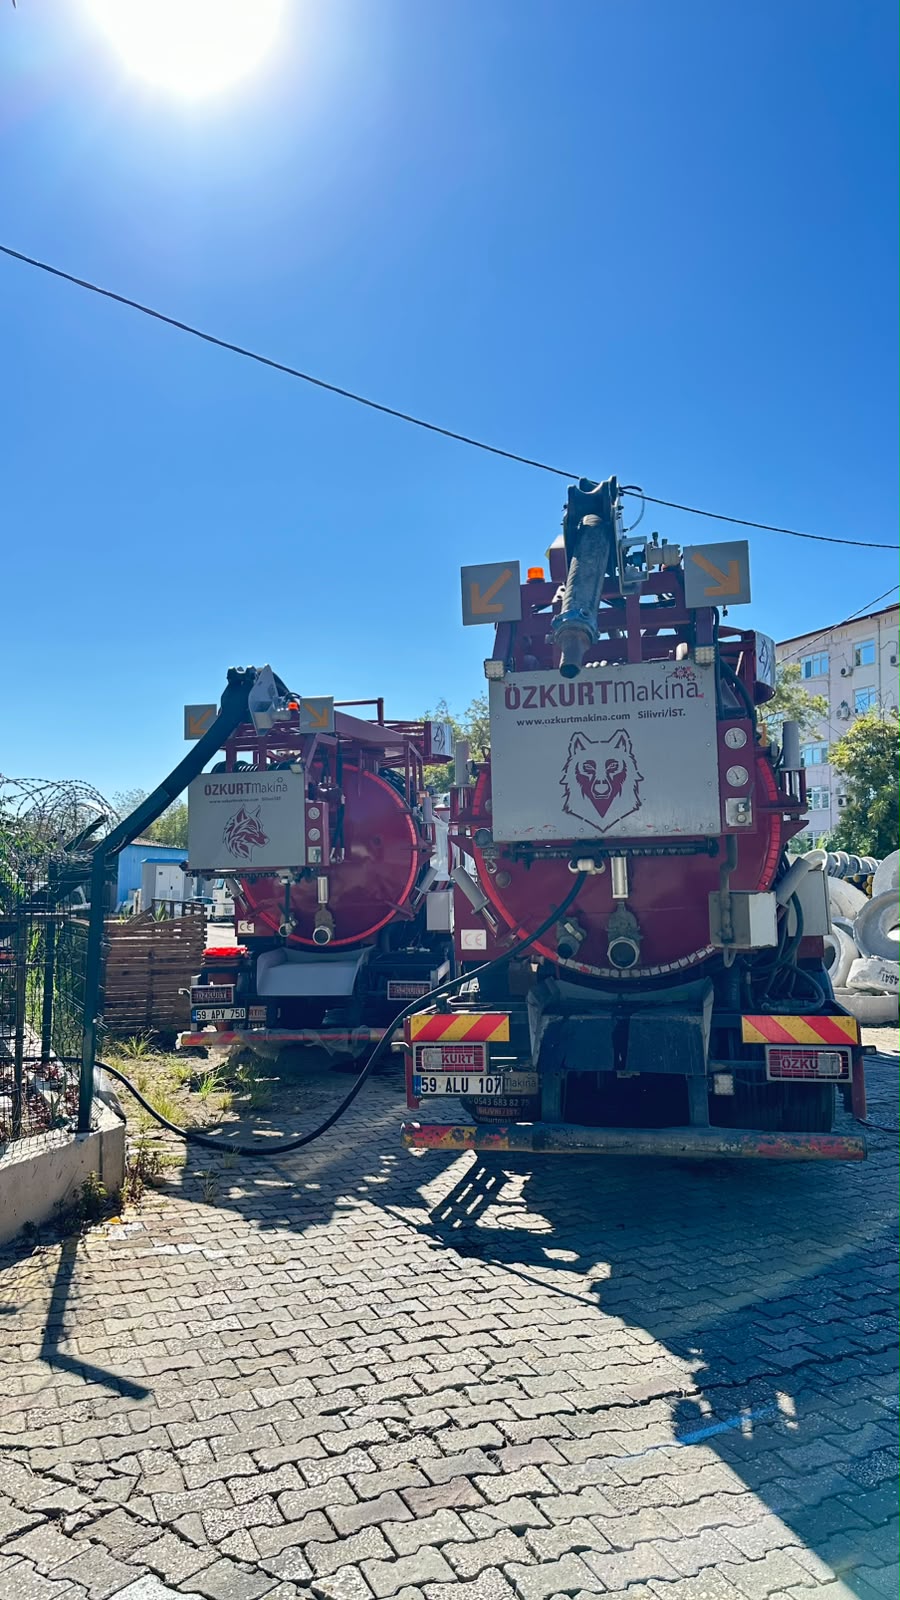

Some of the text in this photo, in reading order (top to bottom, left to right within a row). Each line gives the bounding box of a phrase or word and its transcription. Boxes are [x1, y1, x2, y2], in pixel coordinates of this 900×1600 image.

[516, 713, 630, 726] www.ozkurtmakina.com
[464, 933, 483, 946] CE
[196, 1011, 206, 1019] 59
[211, 1010, 225, 1018] APV
[230, 1009, 245, 1018] 750
[421, 1077, 502, 1094] 59 ALU 107
